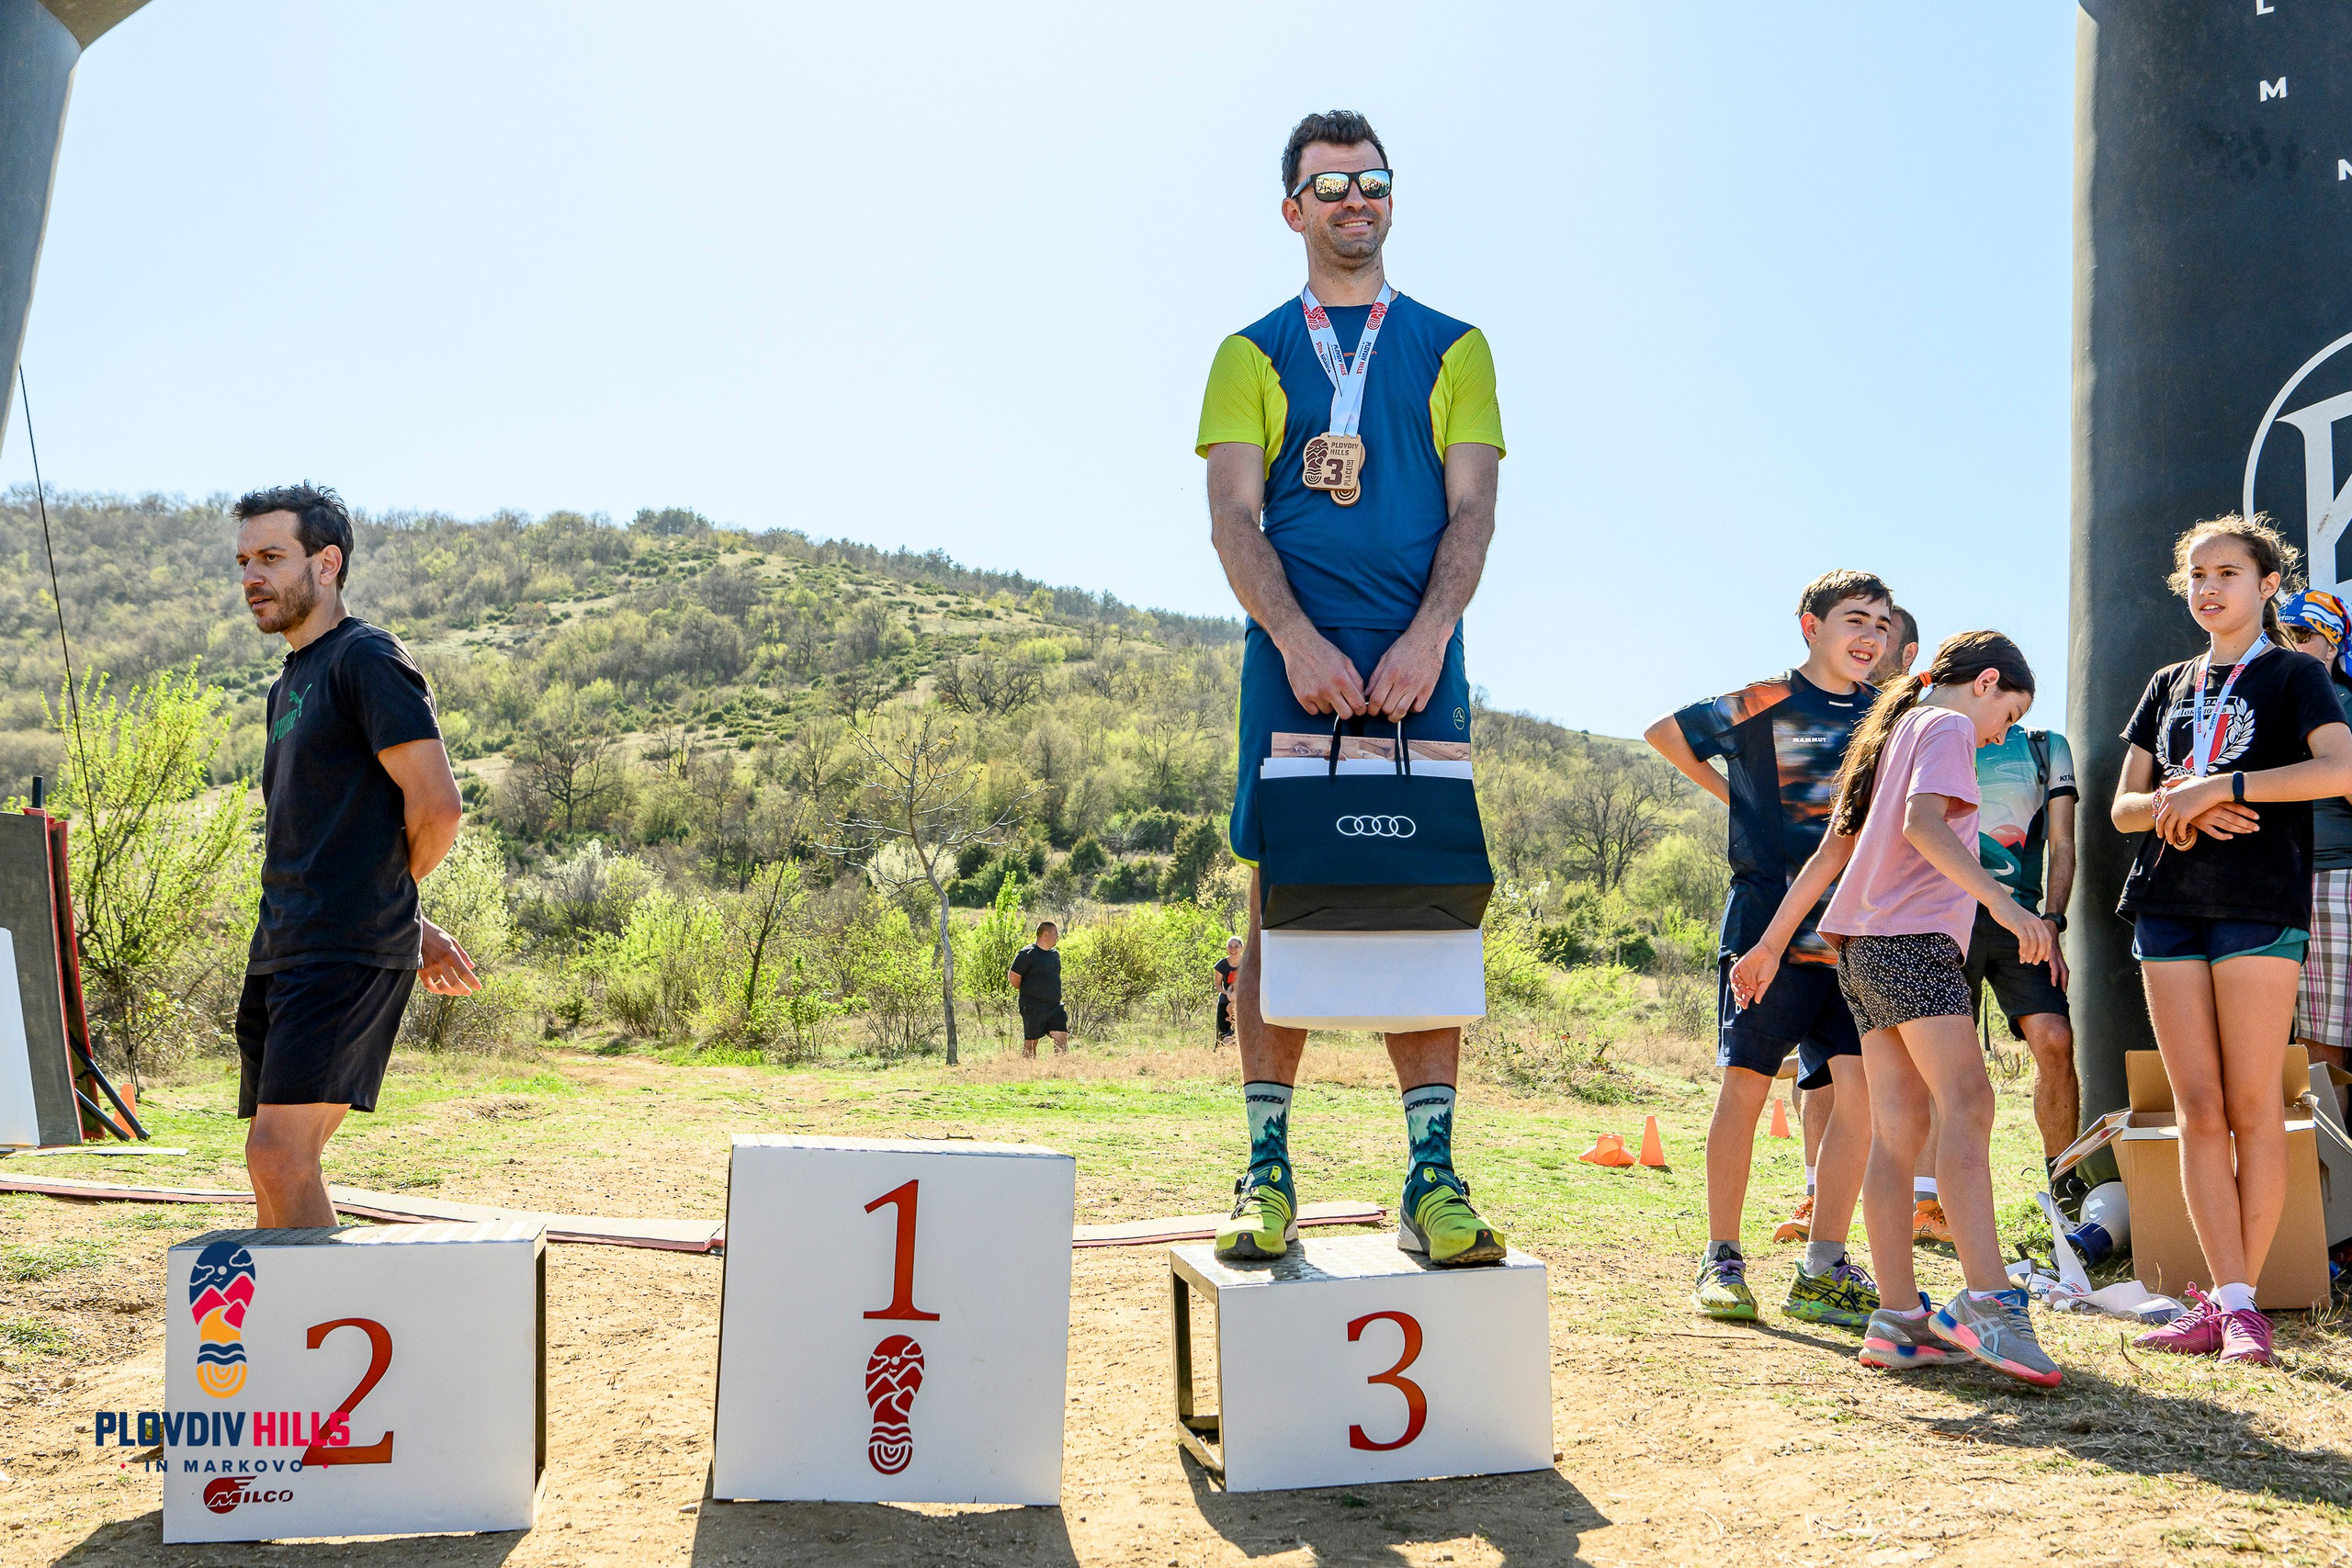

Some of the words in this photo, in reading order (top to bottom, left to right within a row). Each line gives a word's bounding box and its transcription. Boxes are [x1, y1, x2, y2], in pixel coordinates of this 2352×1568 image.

[2259, 76, 2289, 102] M
[1323, 458, 1344, 486] 3
[1246, 1094, 1285, 1105] CRAZY
[1407, 1098, 1450, 1111] CRAZY
[863, 1179, 941, 1323] 1
[301, 1317, 395, 1467] 2
[1346, 1310, 1429, 1451] 3
[206, 1489, 294, 1507] MILCO
